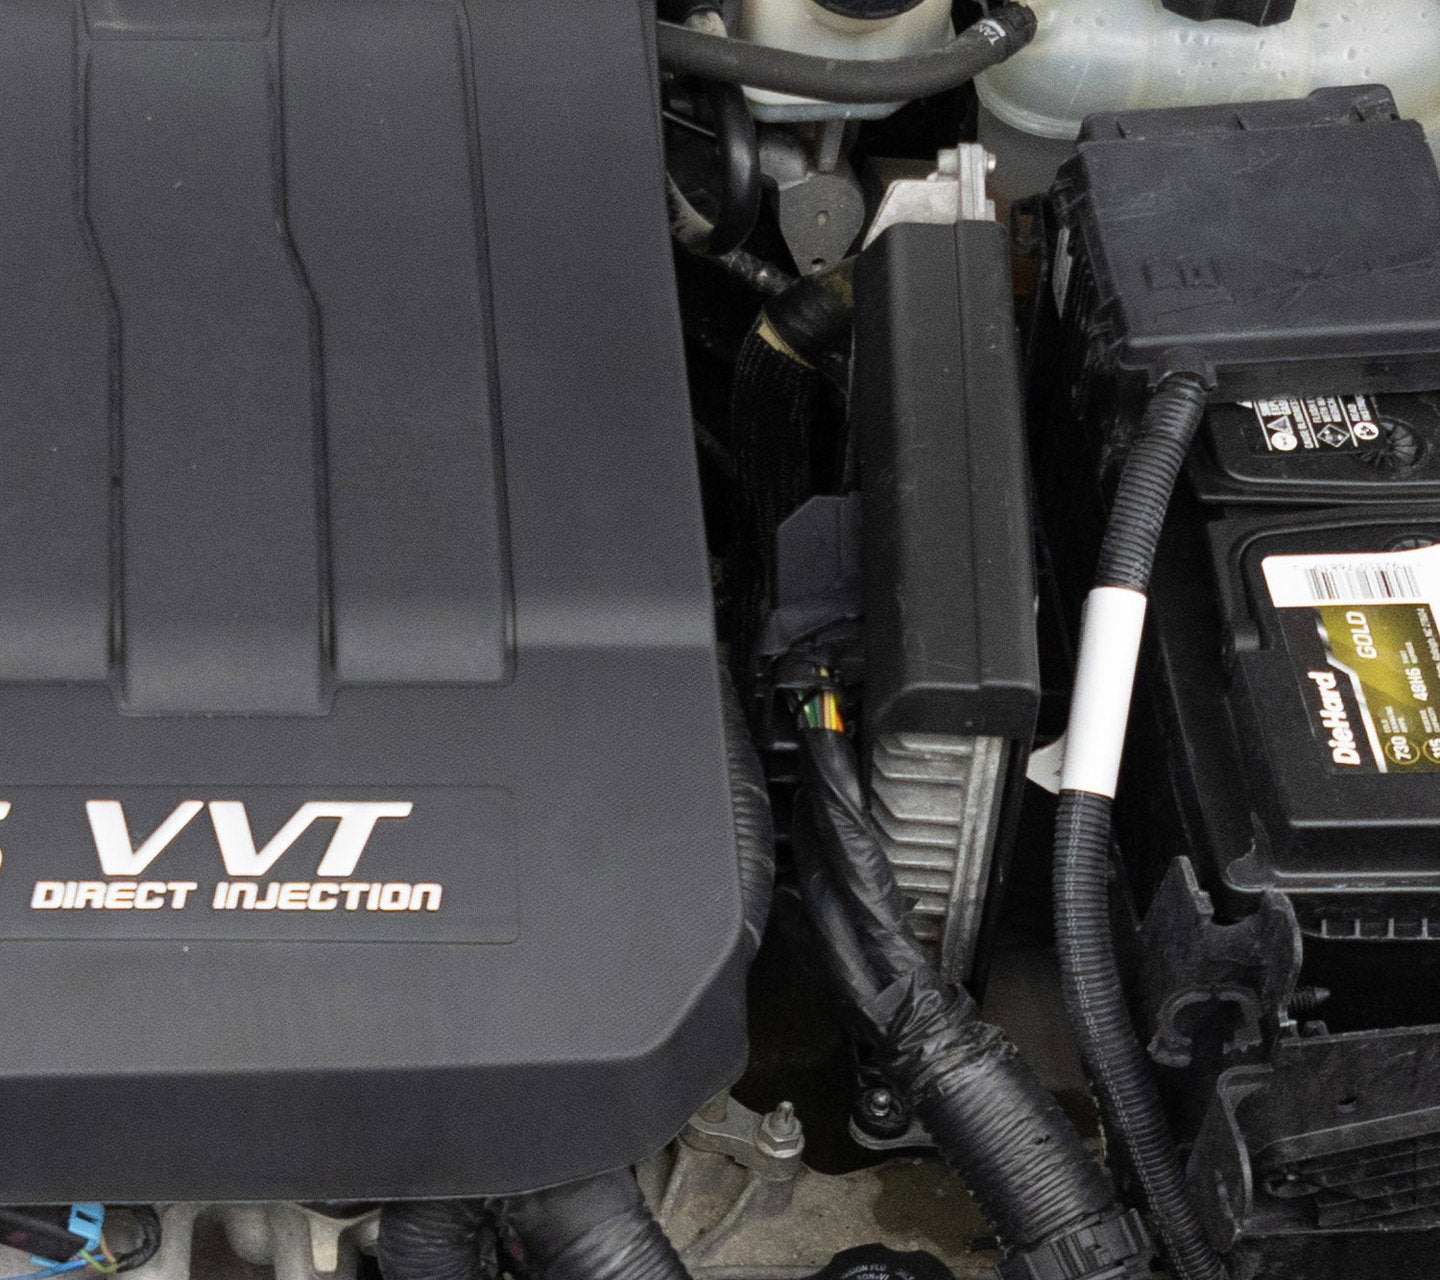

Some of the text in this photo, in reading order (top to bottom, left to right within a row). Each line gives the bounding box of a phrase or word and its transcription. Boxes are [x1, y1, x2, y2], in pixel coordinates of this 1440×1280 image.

[1346, 611, 1377, 659] GOLD
[1307, 670, 1360, 765] DieHard
[1391, 736, 1412, 761] 730
[86, 799, 414, 877] VVT
[31, 882, 442, 911] DIRECT INJECTION
